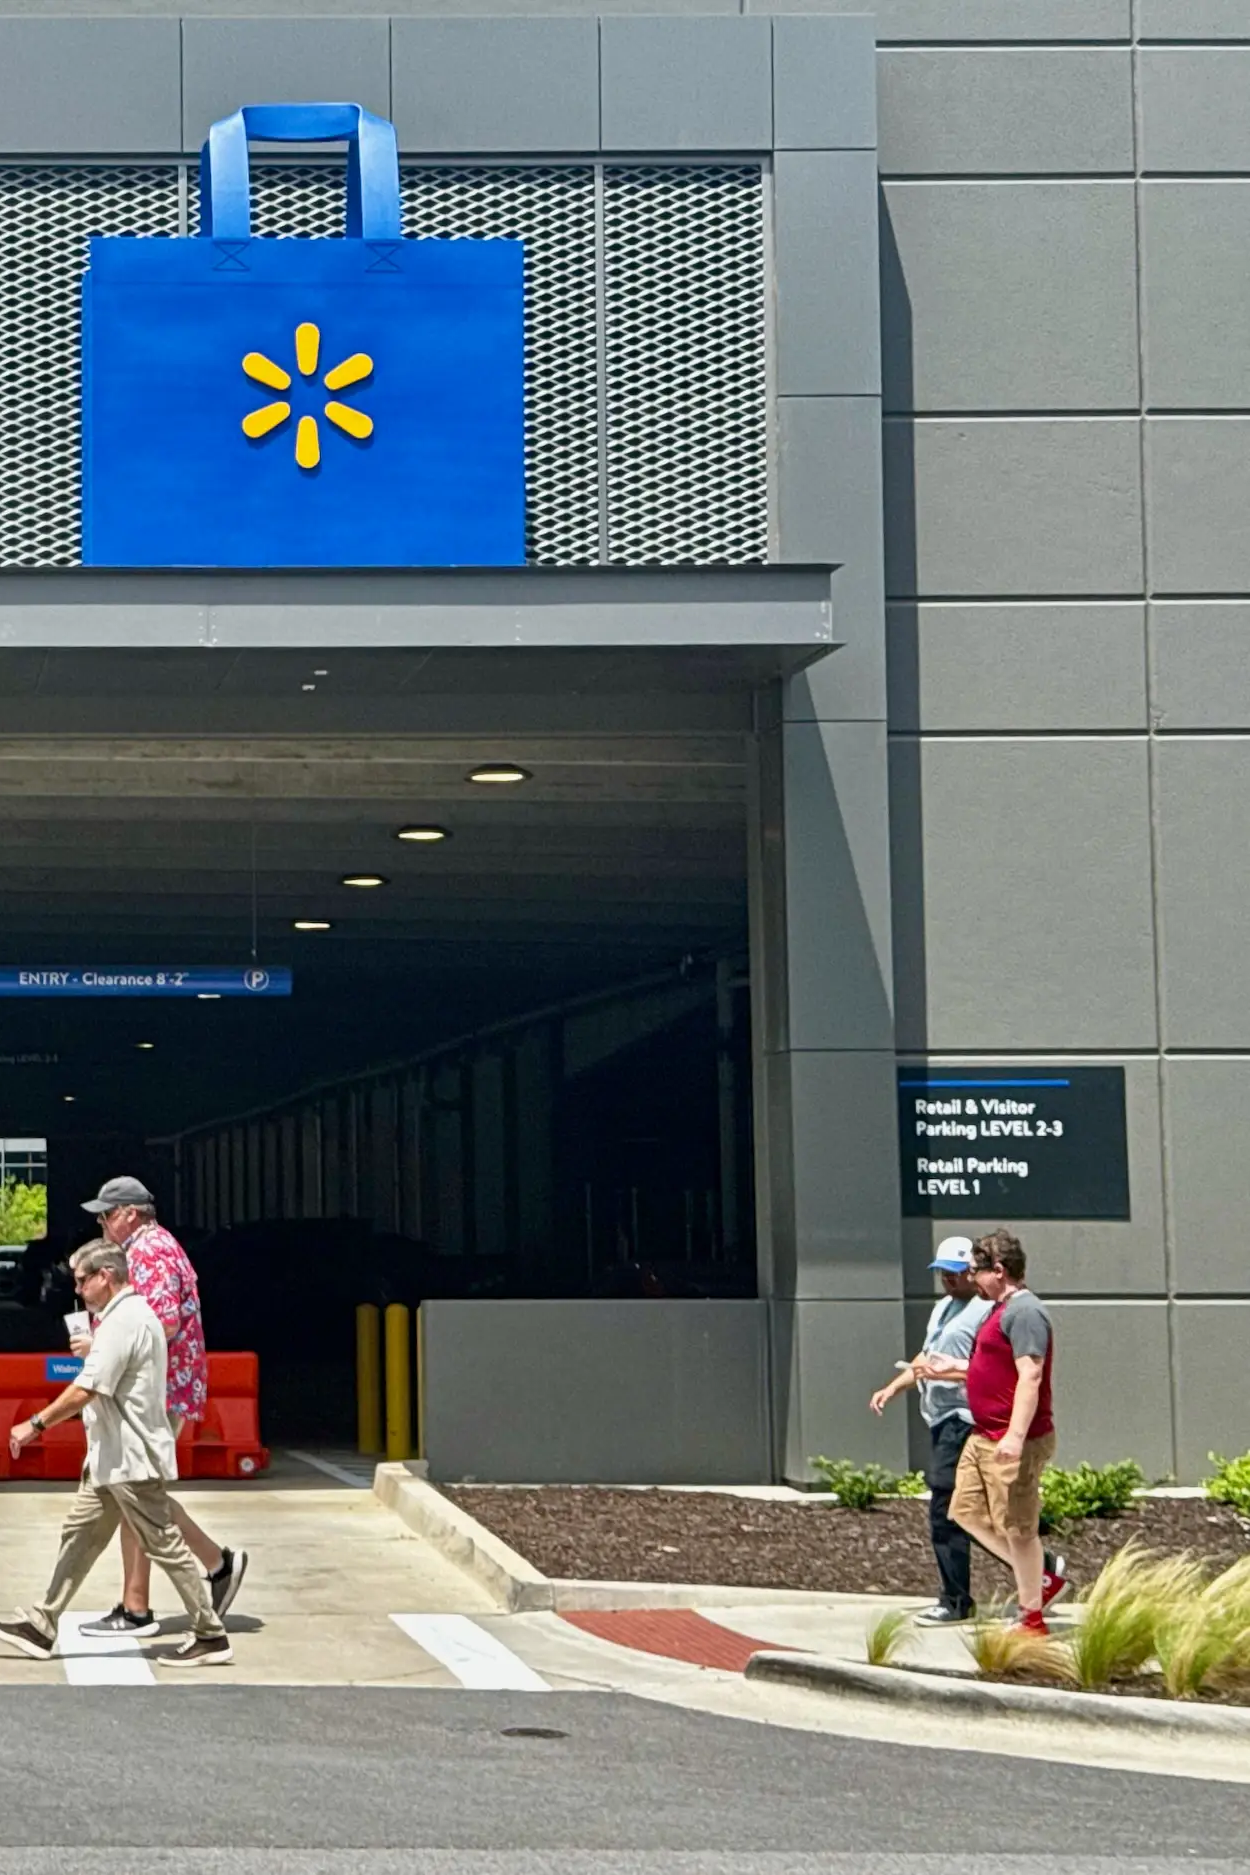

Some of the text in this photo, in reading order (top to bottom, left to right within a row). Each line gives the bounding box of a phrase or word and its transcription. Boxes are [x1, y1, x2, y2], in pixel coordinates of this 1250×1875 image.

[19, 972, 69, 985] ENTRY
[82, 972, 152, 985] Clearance
[915, 1099, 1036, 1115] Retail & Visitor
[915, 1120, 1064, 1140] Parking LEVEL 2-3
[917, 1157, 1029, 1177] Retail Parking
[917, 1179, 981, 1195] LEVEL 1
